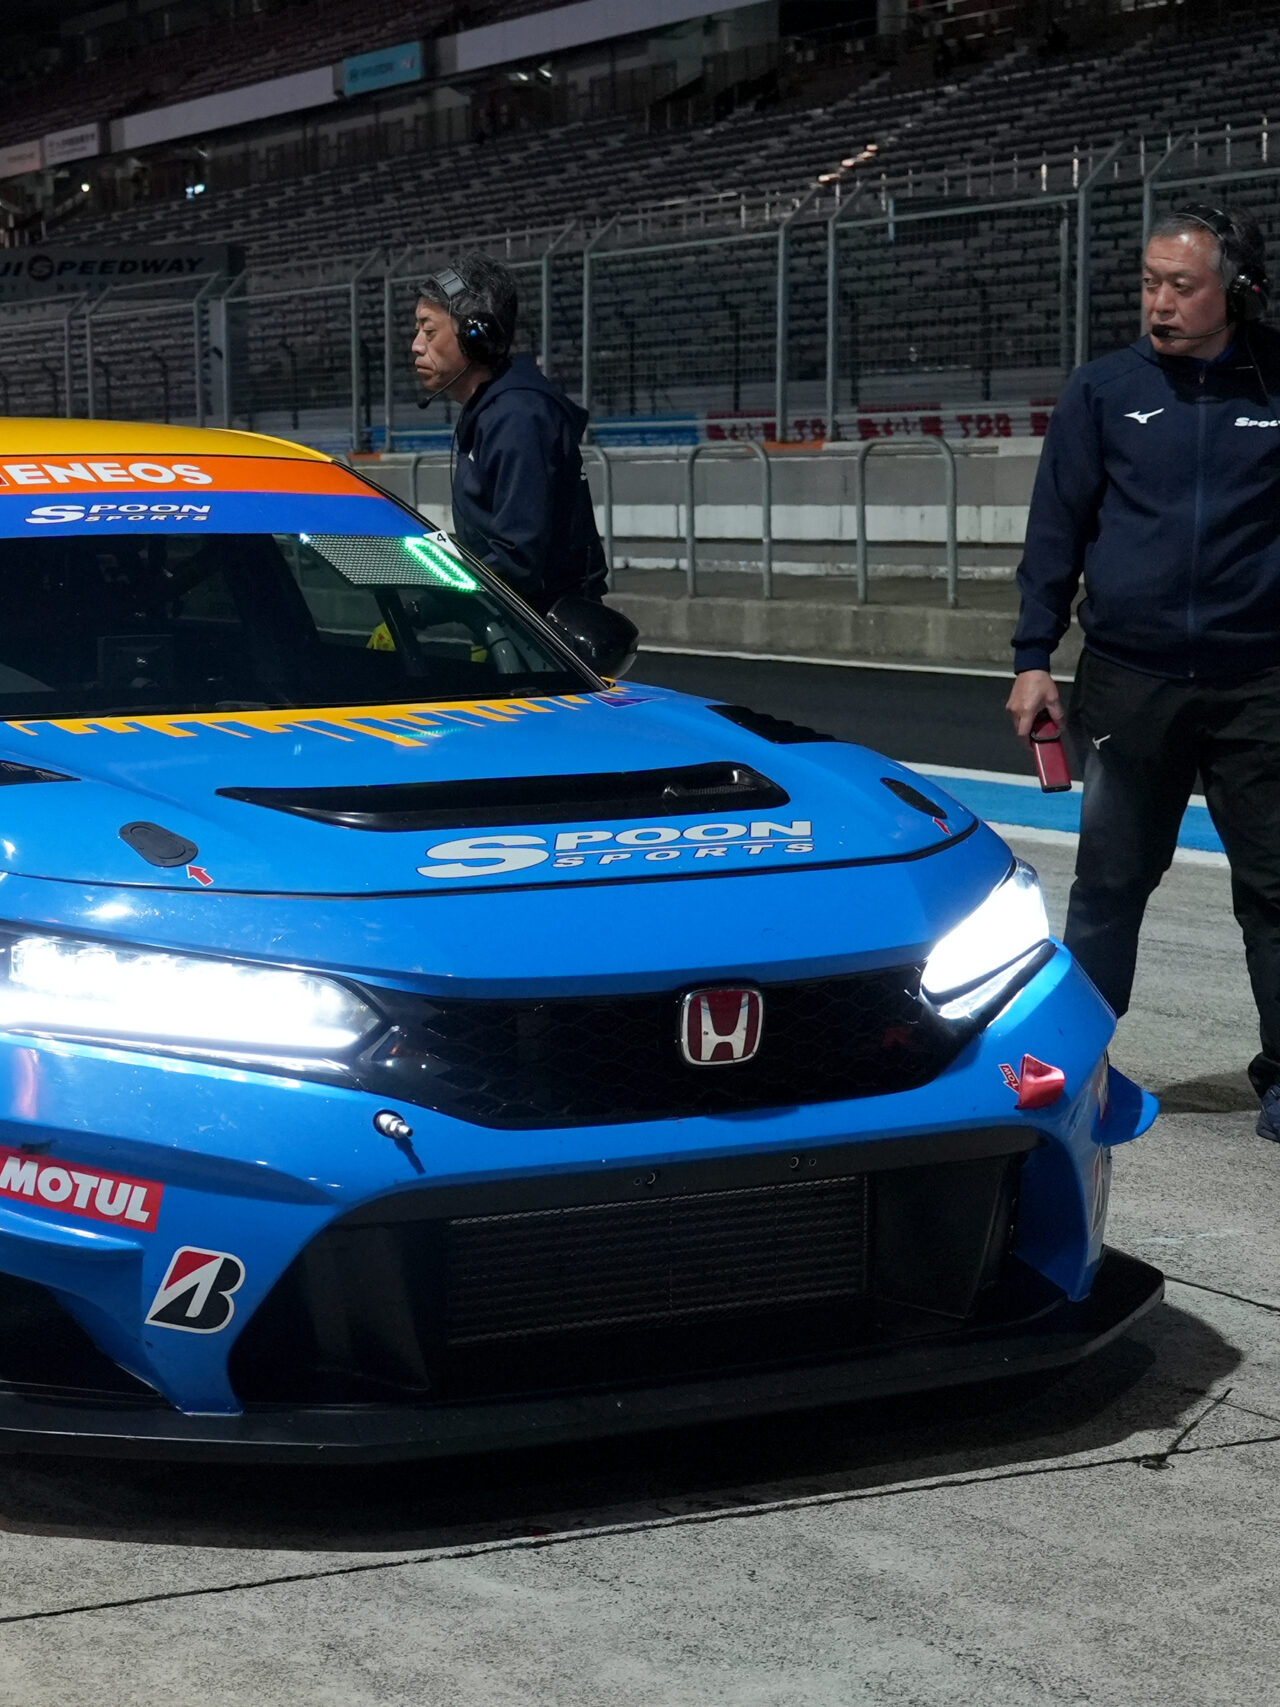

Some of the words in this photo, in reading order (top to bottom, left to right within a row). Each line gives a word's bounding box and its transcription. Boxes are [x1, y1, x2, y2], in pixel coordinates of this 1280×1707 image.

[3, 462, 213, 485] ENEOS
[25, 504, 211, 524] SPOON
[437, 533, 447, 543] 4
[416, 820, 812, 878] SPOON
[553, 843, 815, 868] SPORTS
